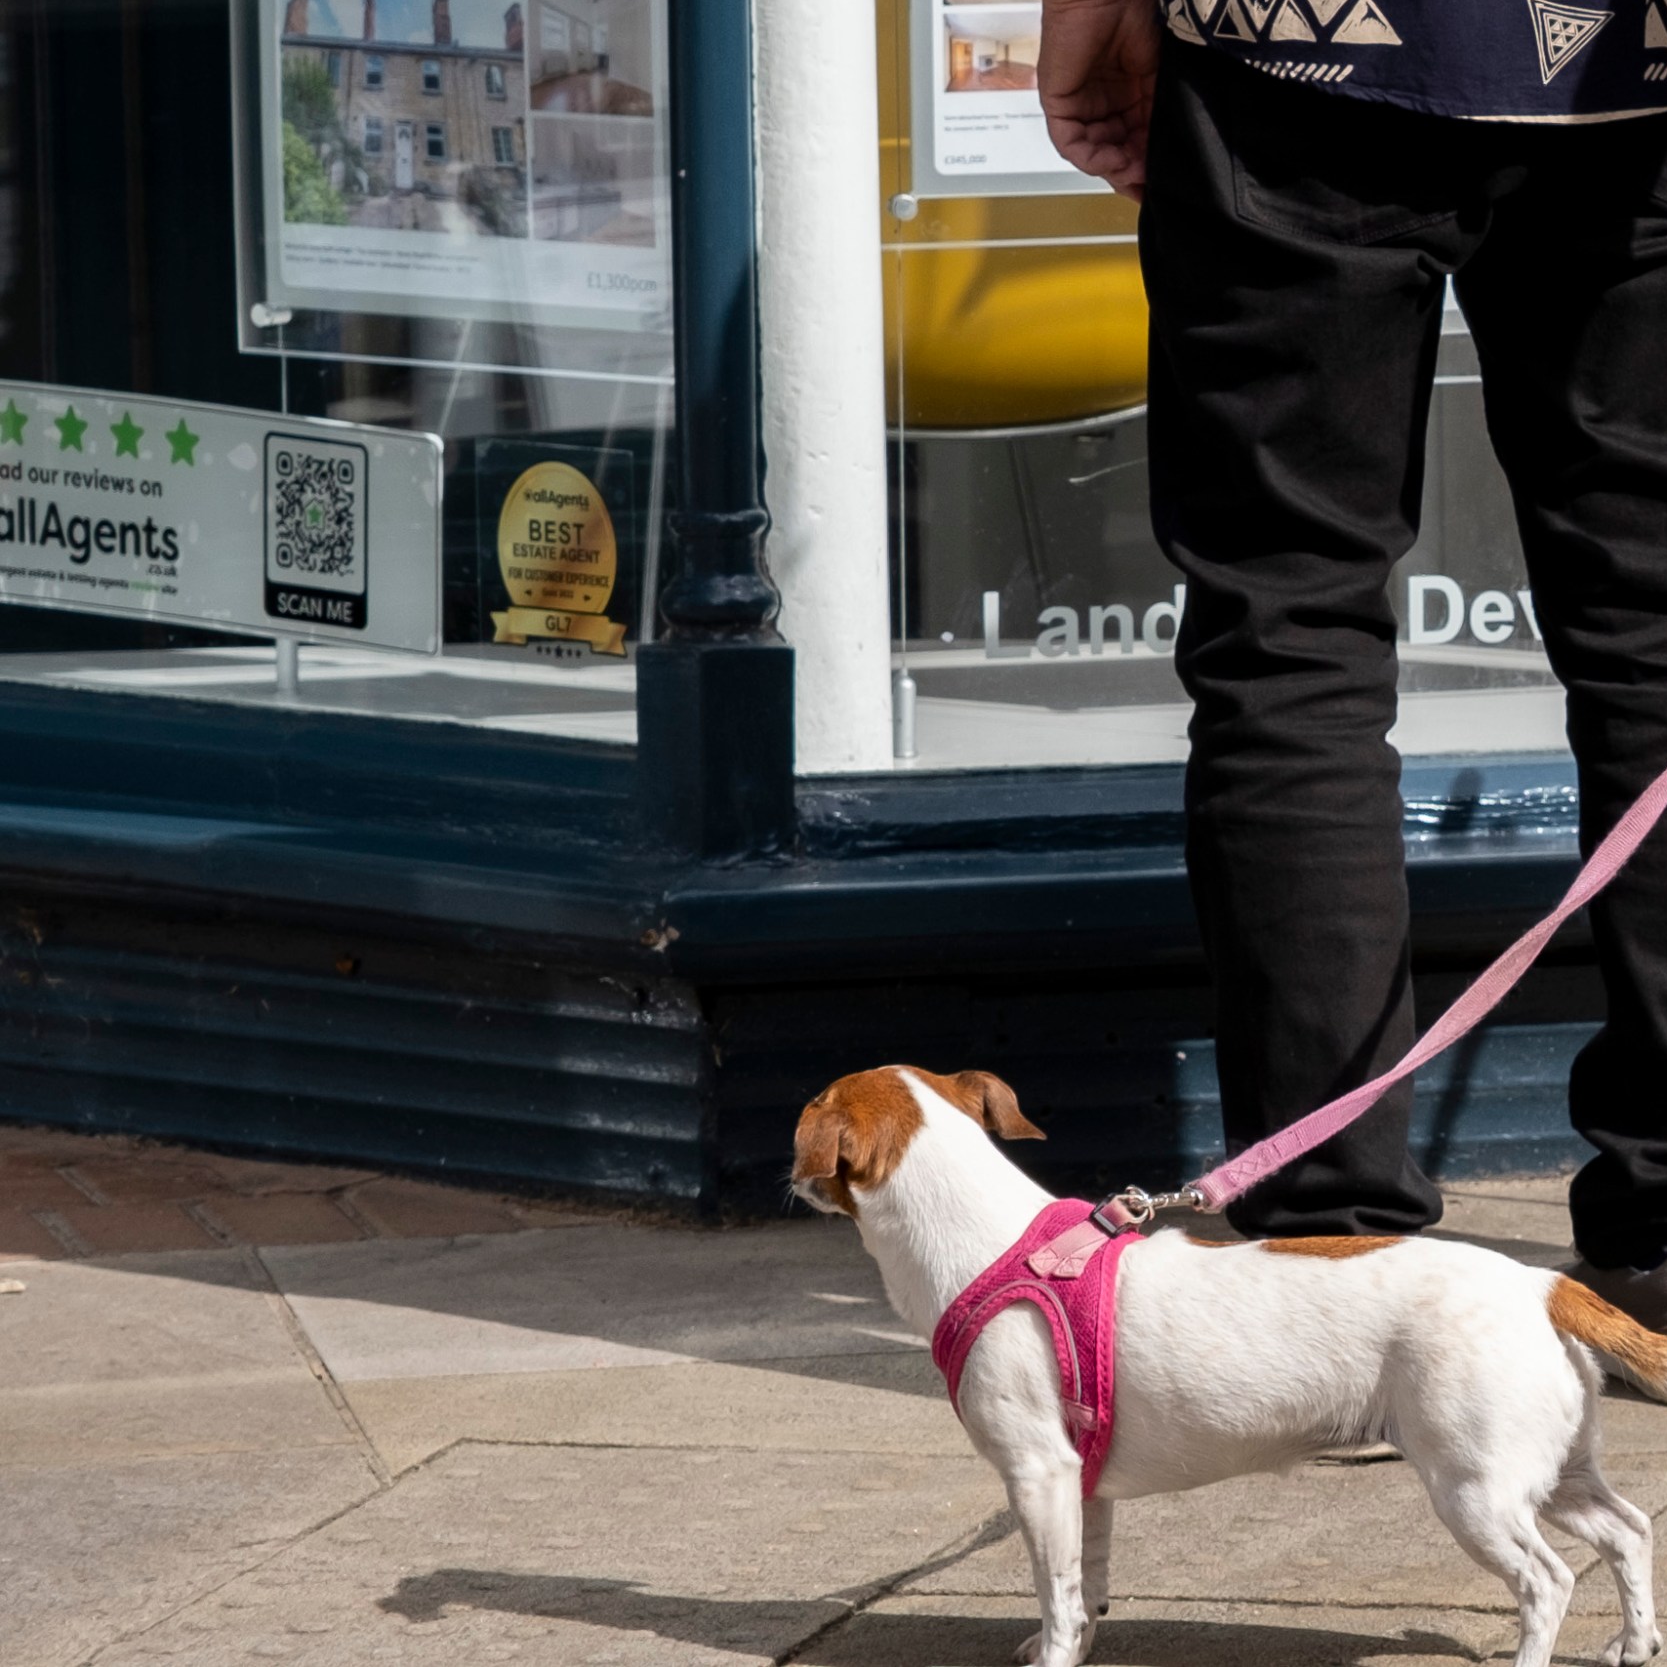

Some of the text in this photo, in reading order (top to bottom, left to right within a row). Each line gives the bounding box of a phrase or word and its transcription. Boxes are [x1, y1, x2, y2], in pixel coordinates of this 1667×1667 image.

[0, 460, 163, 499] ad our reviews on
[0, 495, 180, 566] allAgents
[528, 519, 585, 546] BEST
[512, 543, 601, 565] ESTATE AGENT
[507, 566, 609, 590] FOR CUSTOMER EXPERIENCE
[277, 591, 353, 624] SCAN ME
[545, 615, 572, 633] GL7
